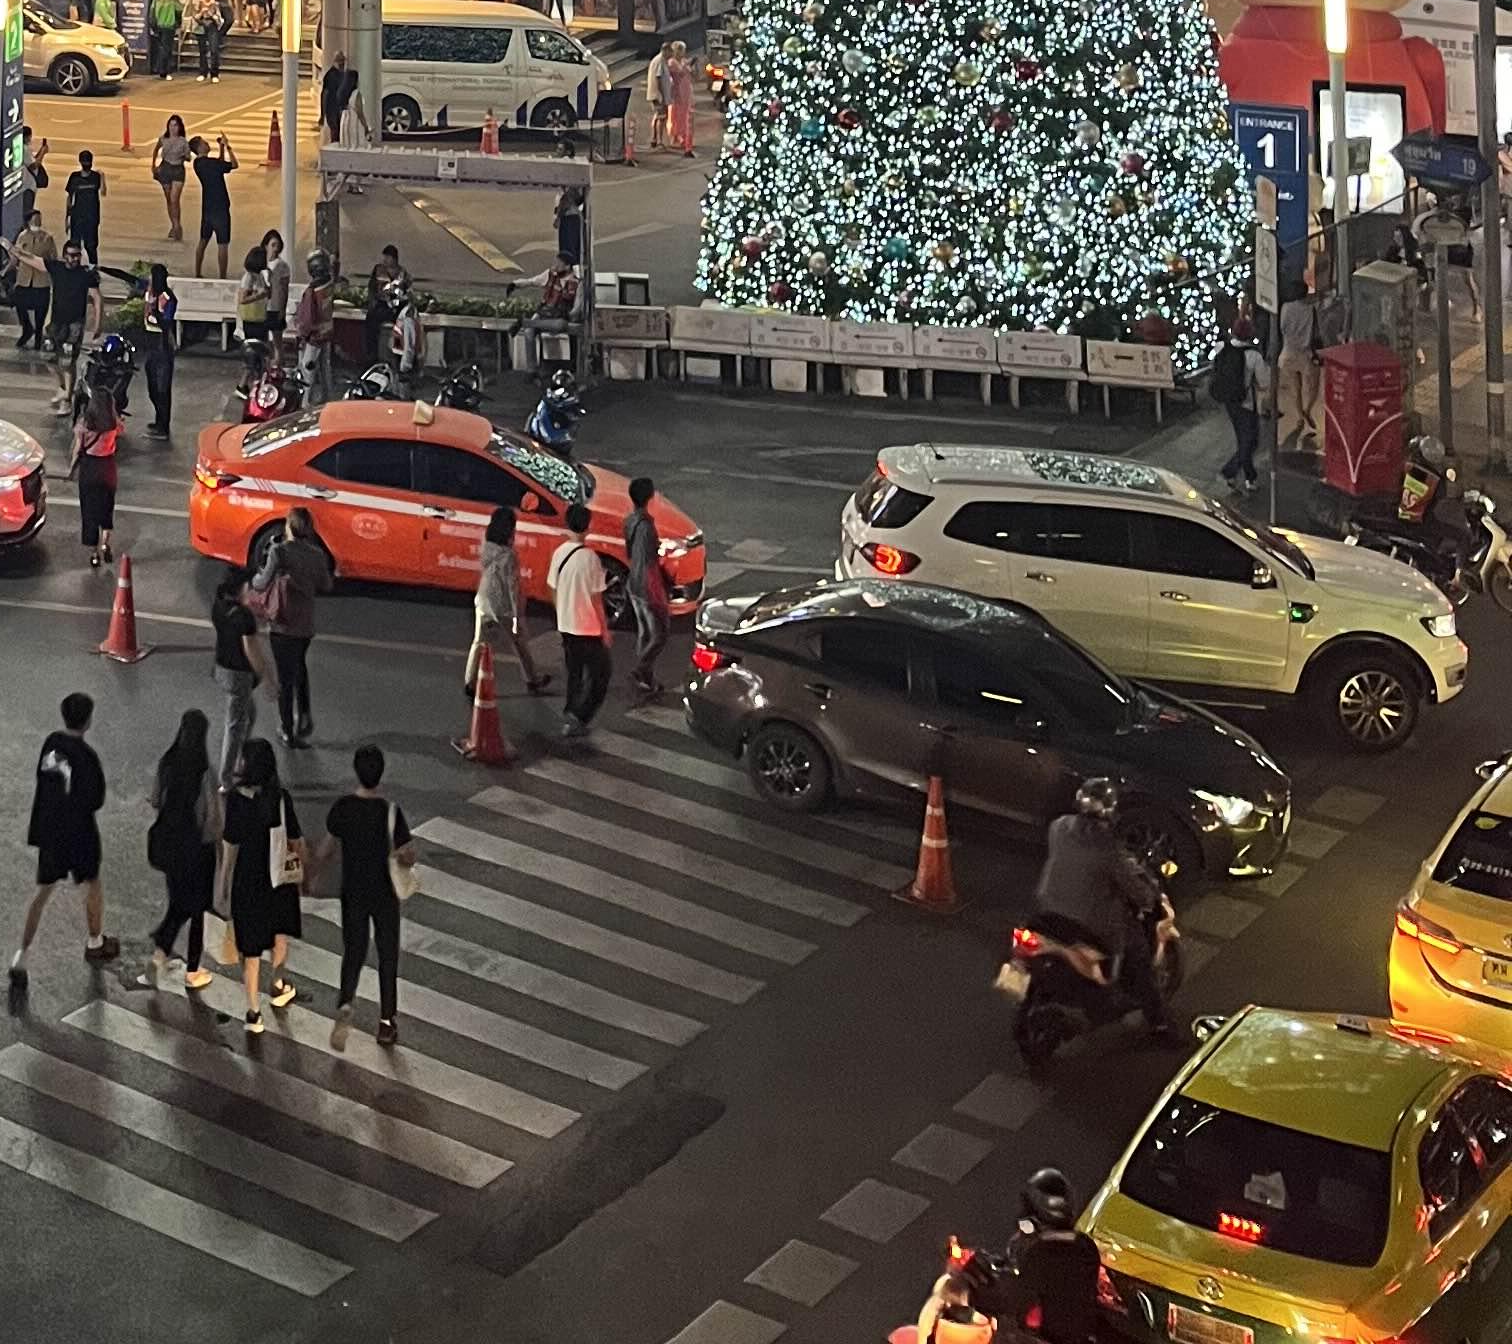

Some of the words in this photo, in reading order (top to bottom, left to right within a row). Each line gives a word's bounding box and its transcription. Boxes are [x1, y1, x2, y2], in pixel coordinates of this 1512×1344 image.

[1239, 117, 1294, 131] ENTRANCE
[1256, 132, 1276, 169] 1
[1462, 158, 1477, 177] 19
